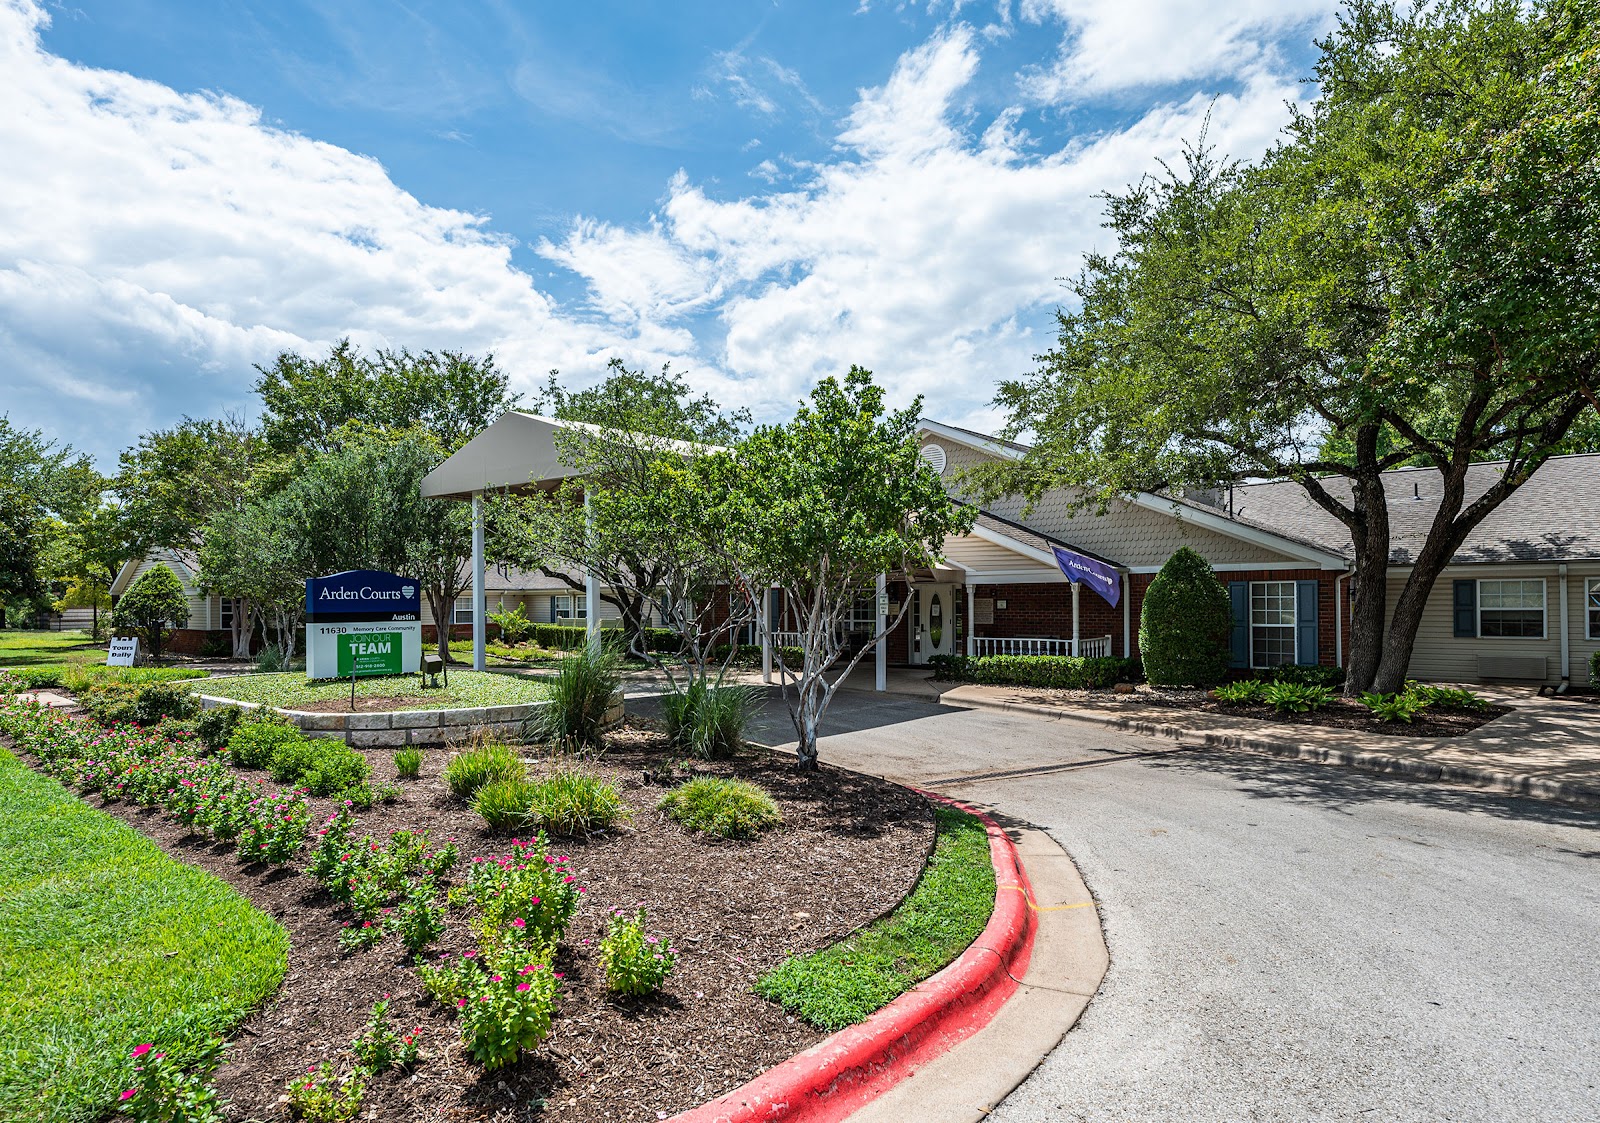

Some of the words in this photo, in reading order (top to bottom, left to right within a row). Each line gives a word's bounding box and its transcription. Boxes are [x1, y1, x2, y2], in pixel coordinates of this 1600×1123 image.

[319, 586, 358, 600] Arden
[360, 586, 400, 600] Courts
[320, 626, 347, 634] 11630
[350, 634, 370, 643] JOIN
[372, 634, 391, 642] OUR
[349, 642, 391, 655] TEAM
